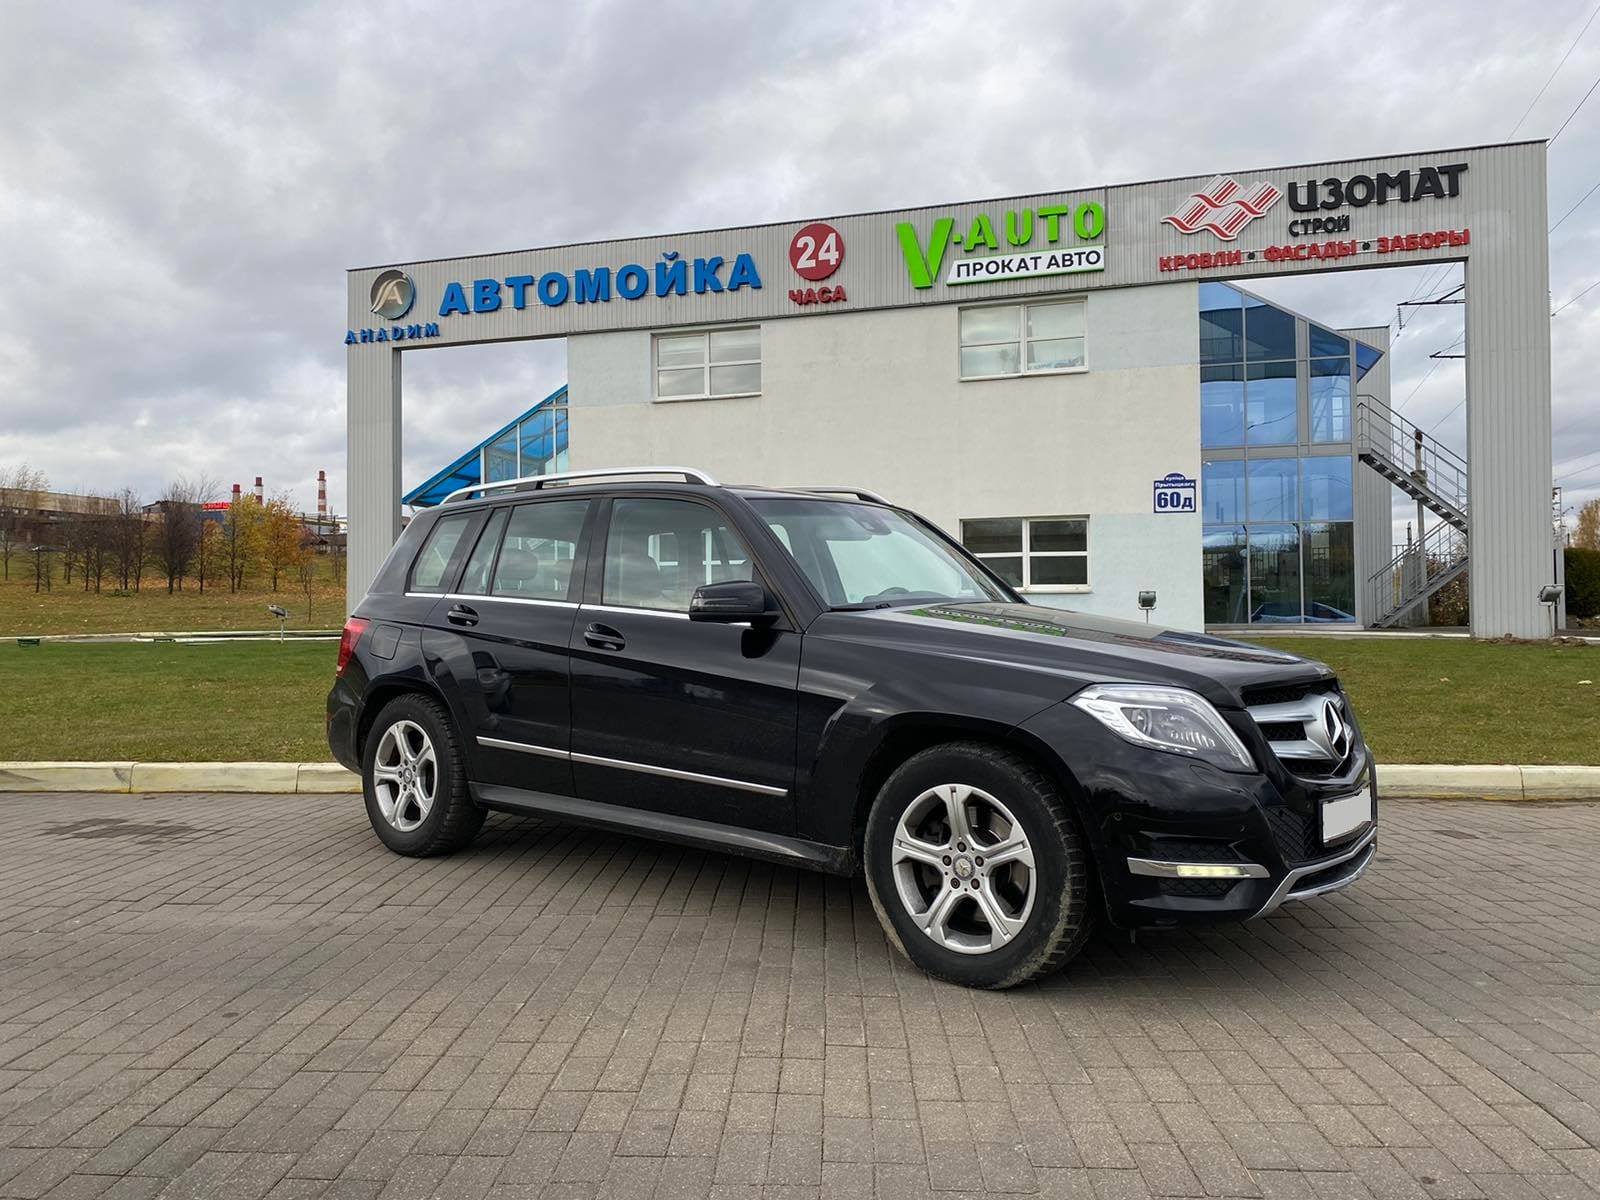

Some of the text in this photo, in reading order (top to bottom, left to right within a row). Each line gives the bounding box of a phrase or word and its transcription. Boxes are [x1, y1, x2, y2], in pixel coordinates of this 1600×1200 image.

[1288, 214, 1350, 237] СТРОЙ
[796, 232, 839, 269] 24
[956, 250, 1101, 278] ПРОКАТ АВТО
[1159, 228, 1470, 272] КРОВЛИ ФАСАДЫ ЗАБОРЫ
[438, 251, 763, 317] АВТОМОЙКА
[788, 285, 847, 306] ЧАСА
